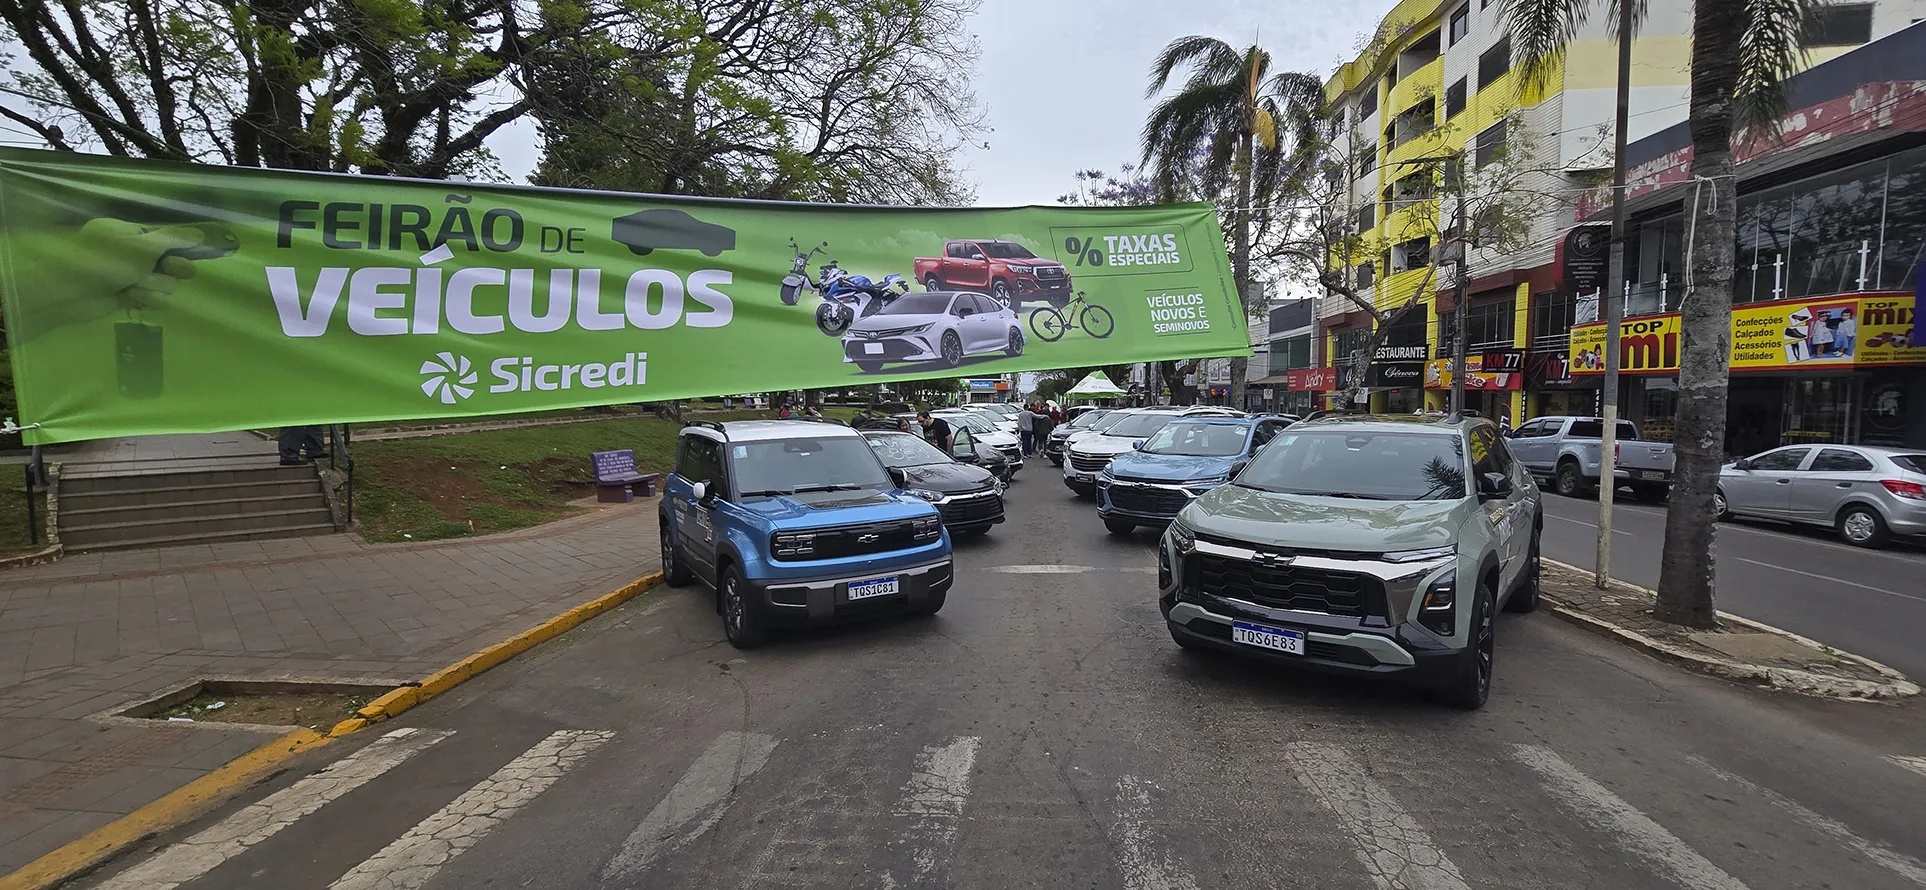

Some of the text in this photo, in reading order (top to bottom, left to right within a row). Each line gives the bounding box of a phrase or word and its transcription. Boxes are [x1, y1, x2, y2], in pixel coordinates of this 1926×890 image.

[276, 193, 586, 254] FEIRÃO DE
[1103, 234, 1176, 254] TAXAS
[1108, 252, 1180, 267] ESPECIAIS
[265, 243, 734, 338] VEÍCULOS
[1147, 293, 1204, 308] VEÍCULOS
[1151, 306, 1206, 321] NOVOS E
[1154, 320, 1210, 334] SEMINOVOS
[1620, 321, 1664, 335] TOP
[1735, 315, 1784, 328] Confecções
[1735, 328, 1775, 340] Calçados
[1373, 346, 1426, 359] ESTAURANTE
[1619, 332, 1682, 370] mi
[1734, 340, 1782, 350] Acessórios
[1486, 353, 1520, 368] KM77
[1734, 351, 1774, 361] Utilidades
[489, 352, 647, 394] Sicredi
[1546, 359, 1571, 379] KM7
[853, 582, 894, 598] TQS1C81
[1239, 629, 1296, 651] TQS6E83
